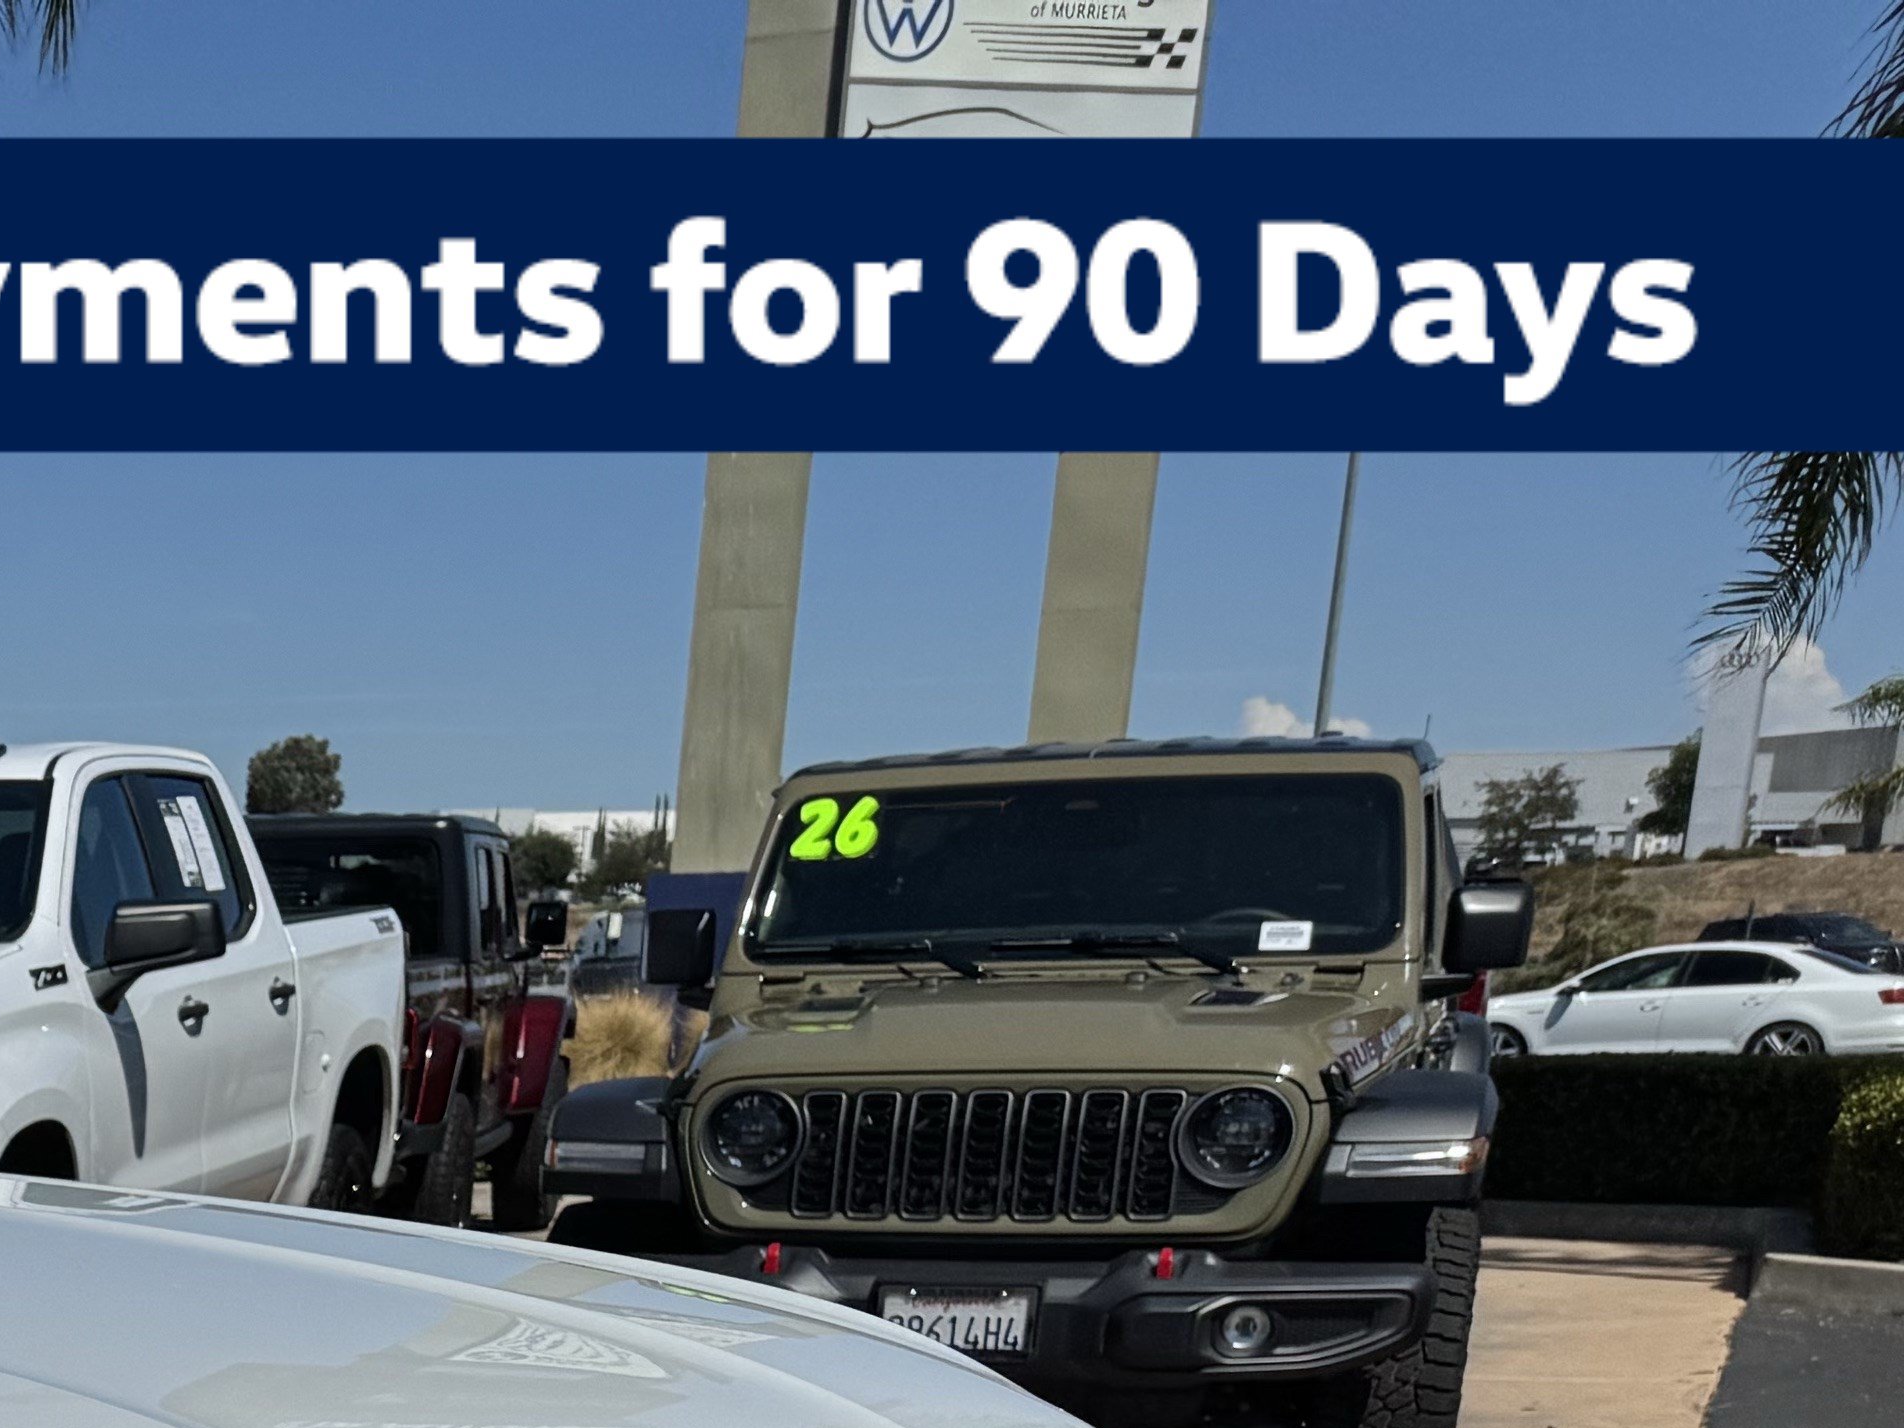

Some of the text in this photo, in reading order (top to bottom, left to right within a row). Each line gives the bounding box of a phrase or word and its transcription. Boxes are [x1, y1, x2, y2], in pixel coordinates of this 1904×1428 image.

[1029, 3, 1127, 21] of MURRIETA
[790, 795, 880, 860] 26
